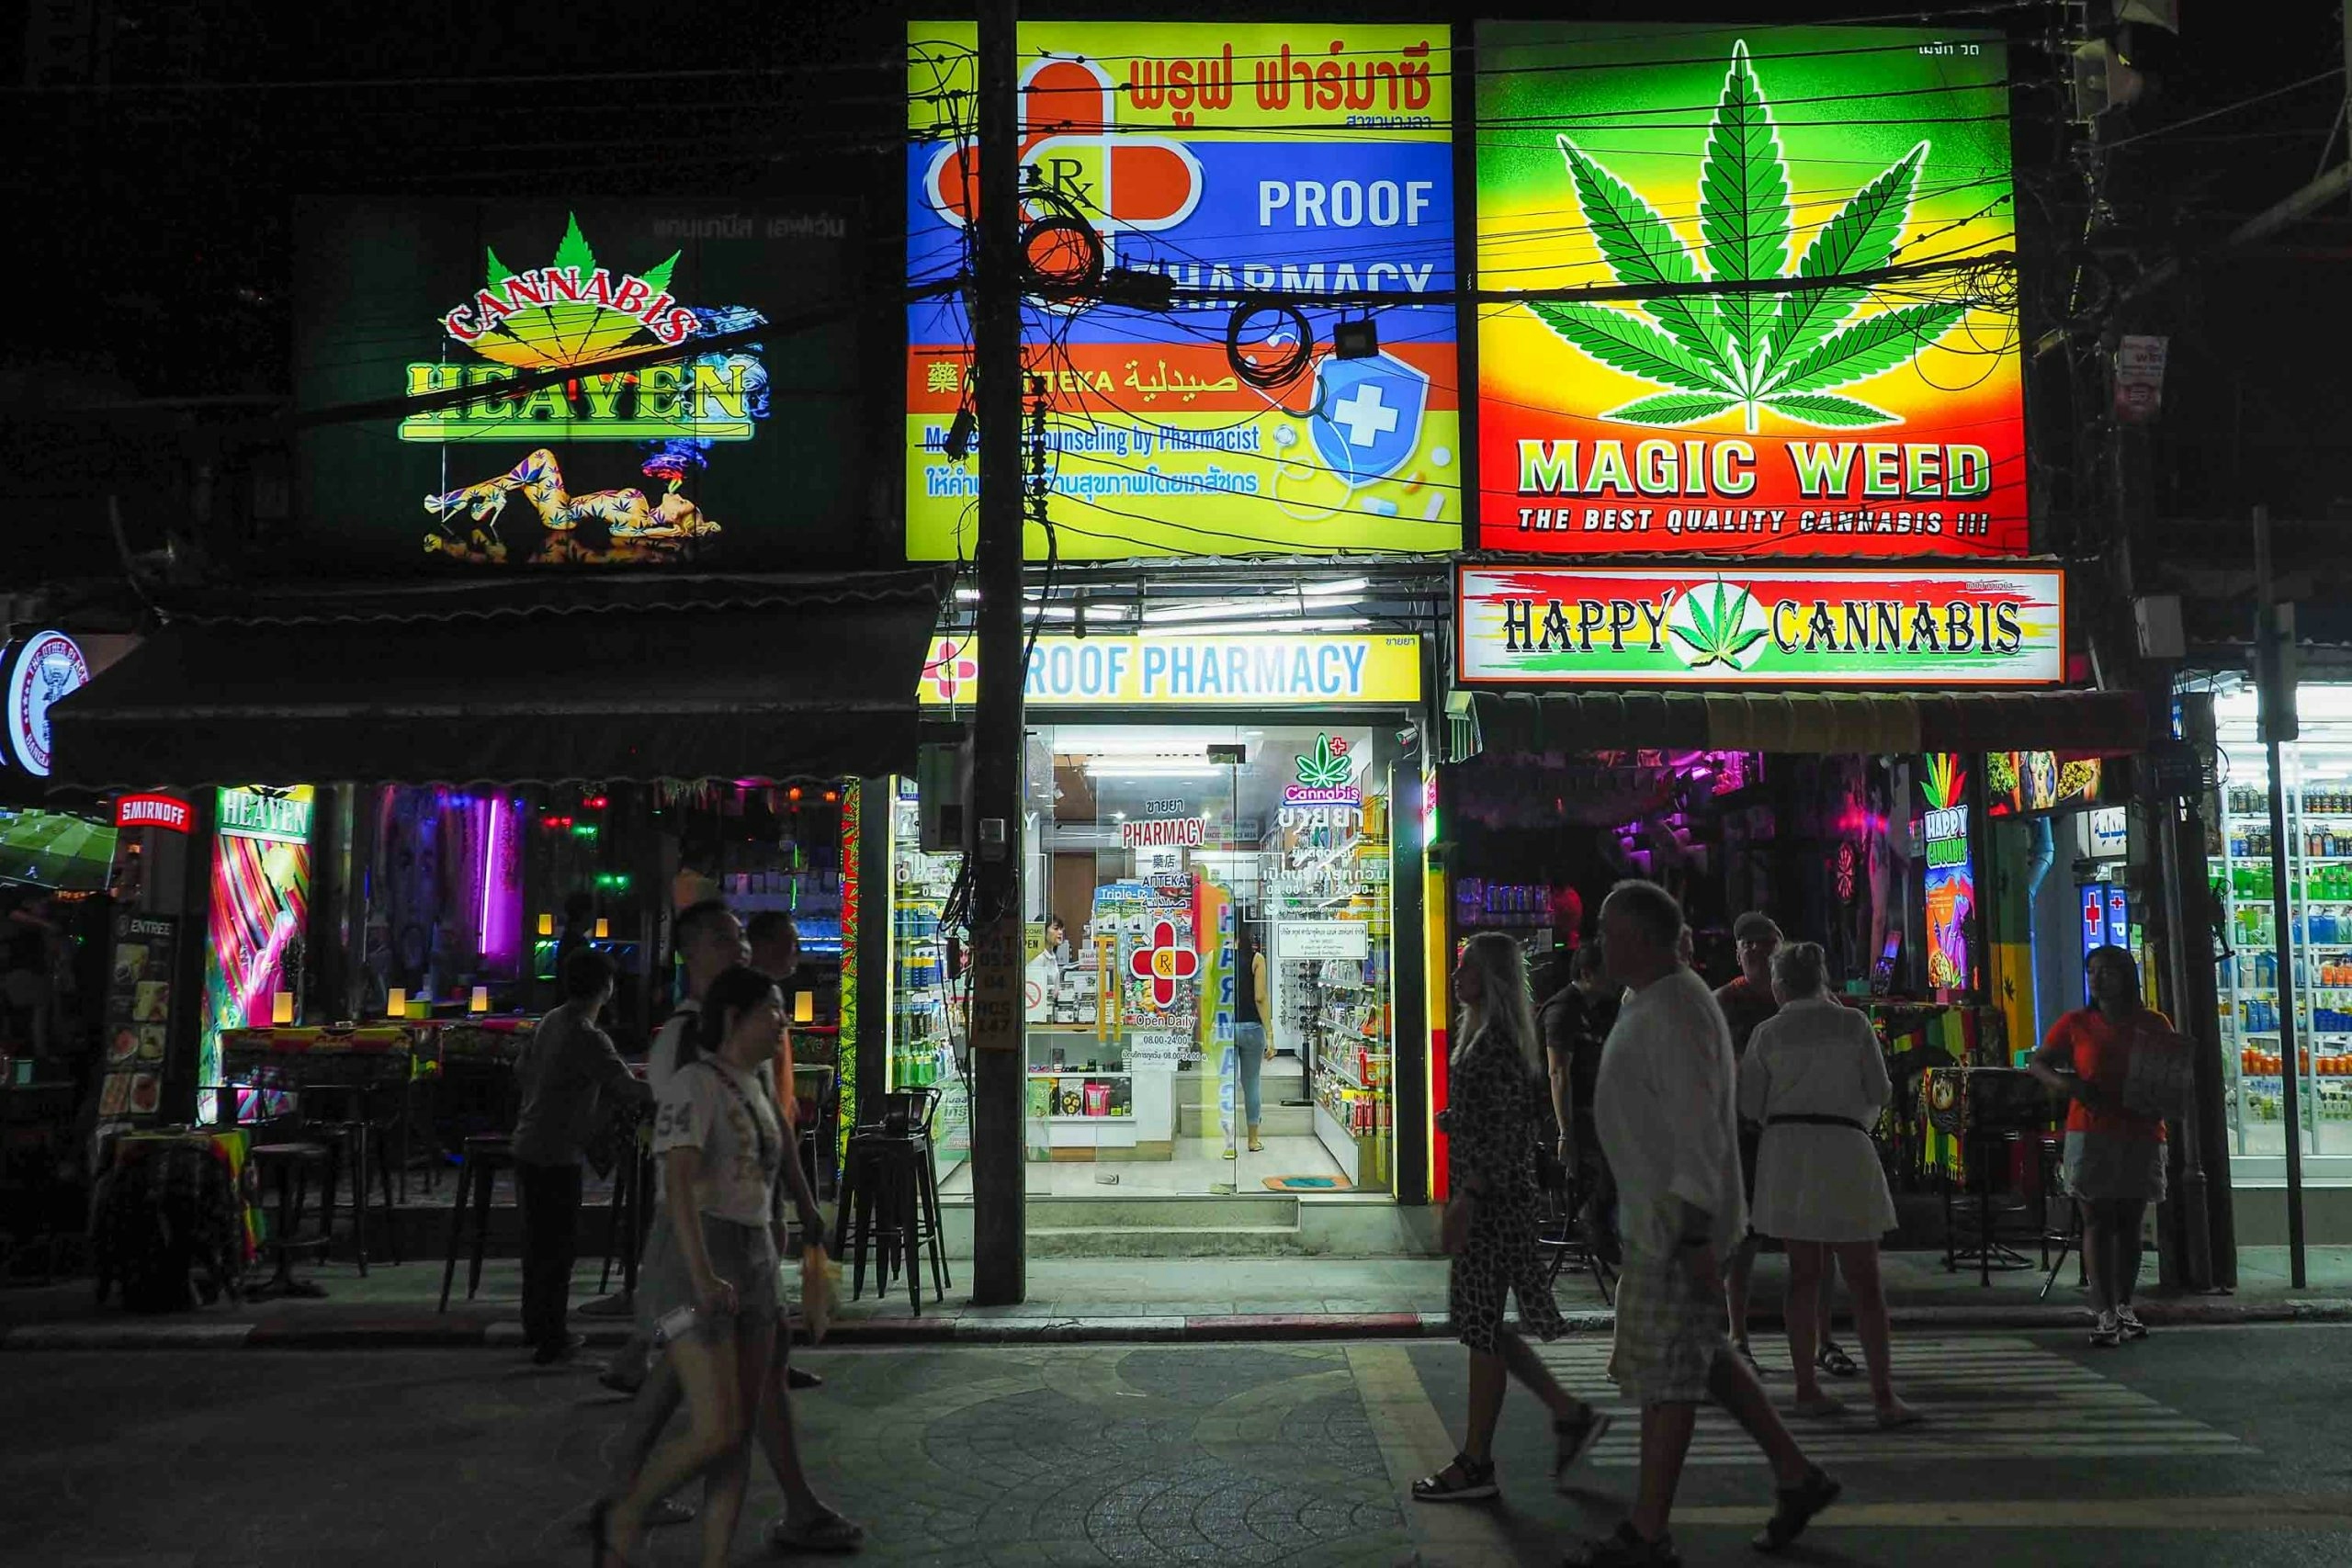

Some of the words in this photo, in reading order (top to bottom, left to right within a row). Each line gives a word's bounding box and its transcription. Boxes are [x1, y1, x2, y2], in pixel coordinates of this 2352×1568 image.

[1130, 42, 1232, 128] พรูฟ
[1255, 40, 1430, 110] ฟาร์มาซี
[1259, 179, 1433, 228] PROOF
[1130, 262, 1435, 310] HARMACY
[446, 265, 703, 345] CANNABIS
[405, 363, 750, 421] HEAVEN
[1123, 358, 1238, 402] صيدلية
[1134, 426, 1154, 459] by
[1159, 425, 1261, 451] Pharmacist
[1517, 438, 1758, 498] MAGIC
[1786, 441, 1992, 501] WEED
[1518, 507, 1570, 532] THE
[1583, 509, 1653, 532] BEST
[1667, 509, 1786, 534] QUALITY
[1800, 510, 1943, 535] CANNABIS
[1501, 586, 1677, 655] HAPPY
[1771, 598, 2024, 656] CANNABIS
[1023, 645, 1128, 695] ROOF
[1144, 644, 1367, 696] PHARMACY
[1147, 799, 1183, 813] ขายยา
[1285, 785, 1361, 801] Cannabis
[122, 802, 185, 826] SMIRNOFF
[221, 789, 309, 834] HEAVEN
[1925, 805, 1968, 842] HAPPY
[1122, 818, 1206, 848] PHARMACY
[1927, 837, 1968, 870] CANNABIS
[1141, 874, 1188, 888] АПТЕКА
[130, 919, 174, 935] ENTREE
[1024, 939, 1039, 950] EN
[1136, 1014, 1166, 1029] Open
[1167, 1013, 1195, 1028] Daily
